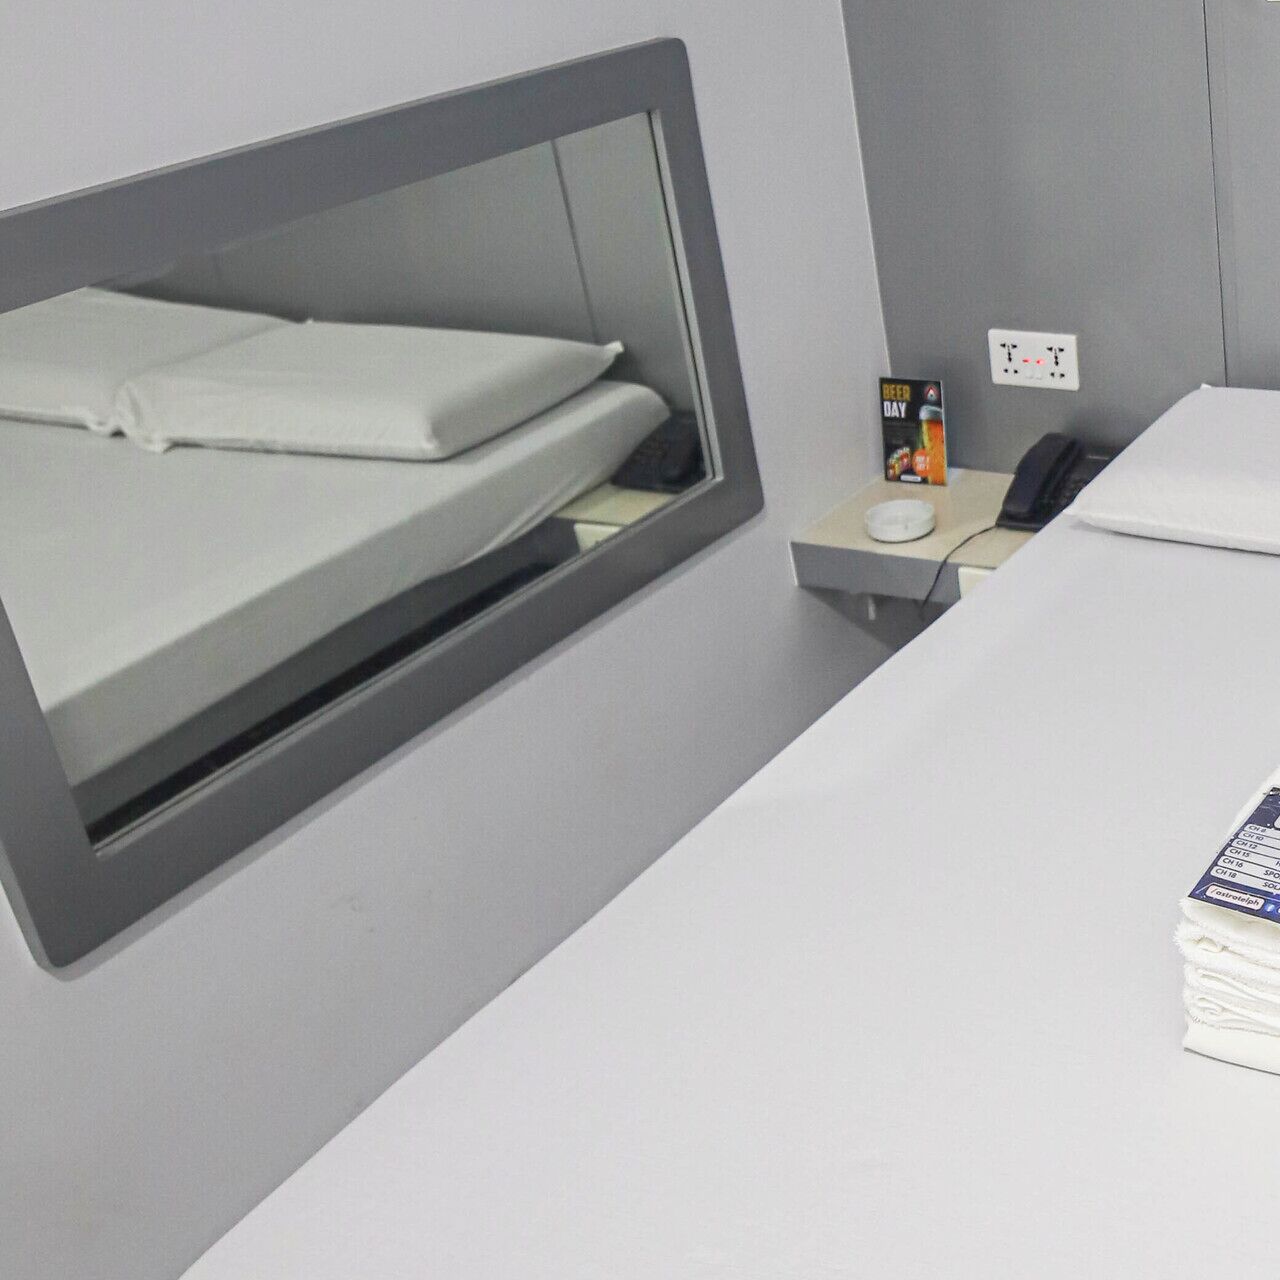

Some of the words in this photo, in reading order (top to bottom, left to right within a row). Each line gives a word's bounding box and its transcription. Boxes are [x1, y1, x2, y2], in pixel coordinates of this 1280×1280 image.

[882, 383, 911, 401] BEER
[883, 401, 907, 418] DAY
[1236, 839, 1248, 847] CH
[1229, 848, 1241, 856] CH
[1242, 850, 1250, 858] 15
[1222, 857, 1234, 865] CH
[1235, 860, 1243, 868] 16
[1215, 867, 1227, 875] CH
[1228, 871, 1237, 879] 18
[1210, 888, 1260, 906] /astrotelph
